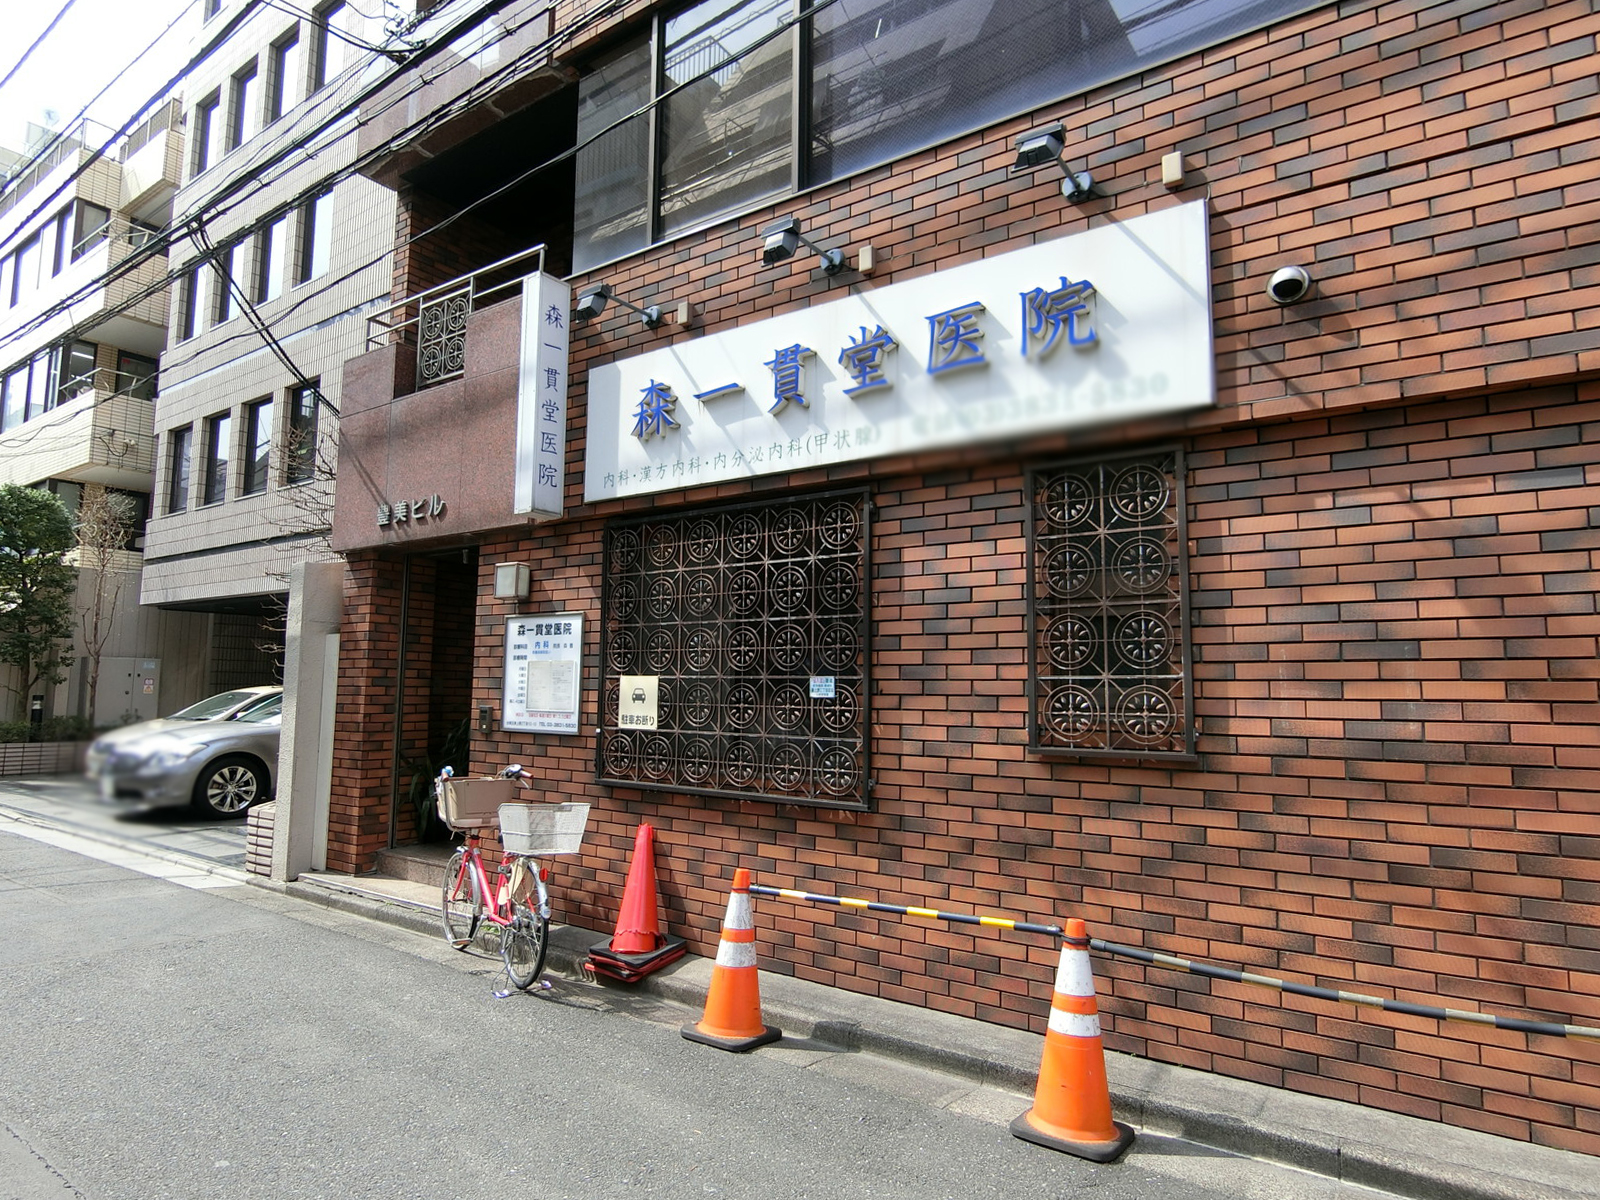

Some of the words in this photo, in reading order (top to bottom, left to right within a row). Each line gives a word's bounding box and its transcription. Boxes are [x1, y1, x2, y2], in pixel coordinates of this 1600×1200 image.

[538, 304, 563, 488] 森一貫堂医院
[630, 276, 1098, 440] 森一貫堂医院
[517, 622, 572, 636] 森一貫堂医院
[621, 714, 655, 726] 駐車お断り
